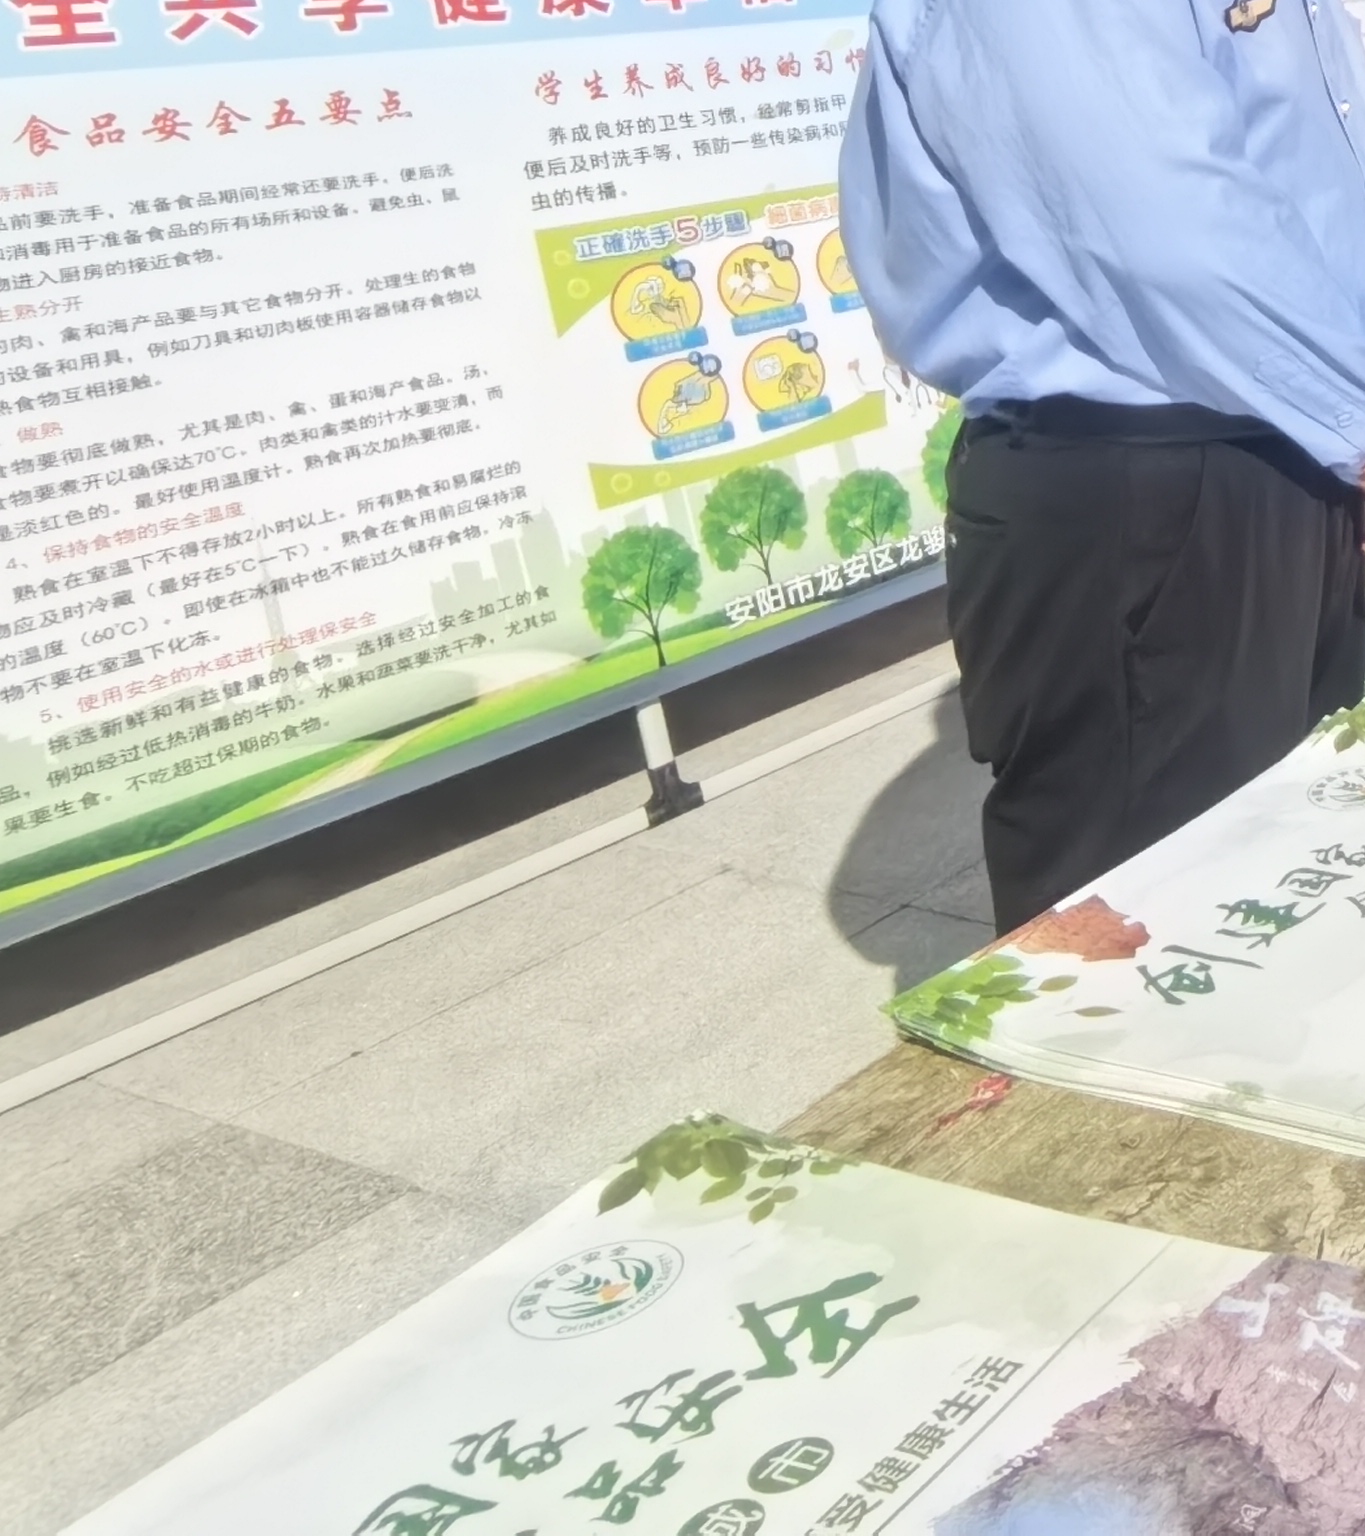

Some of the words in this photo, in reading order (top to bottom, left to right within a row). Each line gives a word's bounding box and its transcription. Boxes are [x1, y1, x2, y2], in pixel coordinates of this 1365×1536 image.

[13, 87, 414, 158] 食品安全五要点
